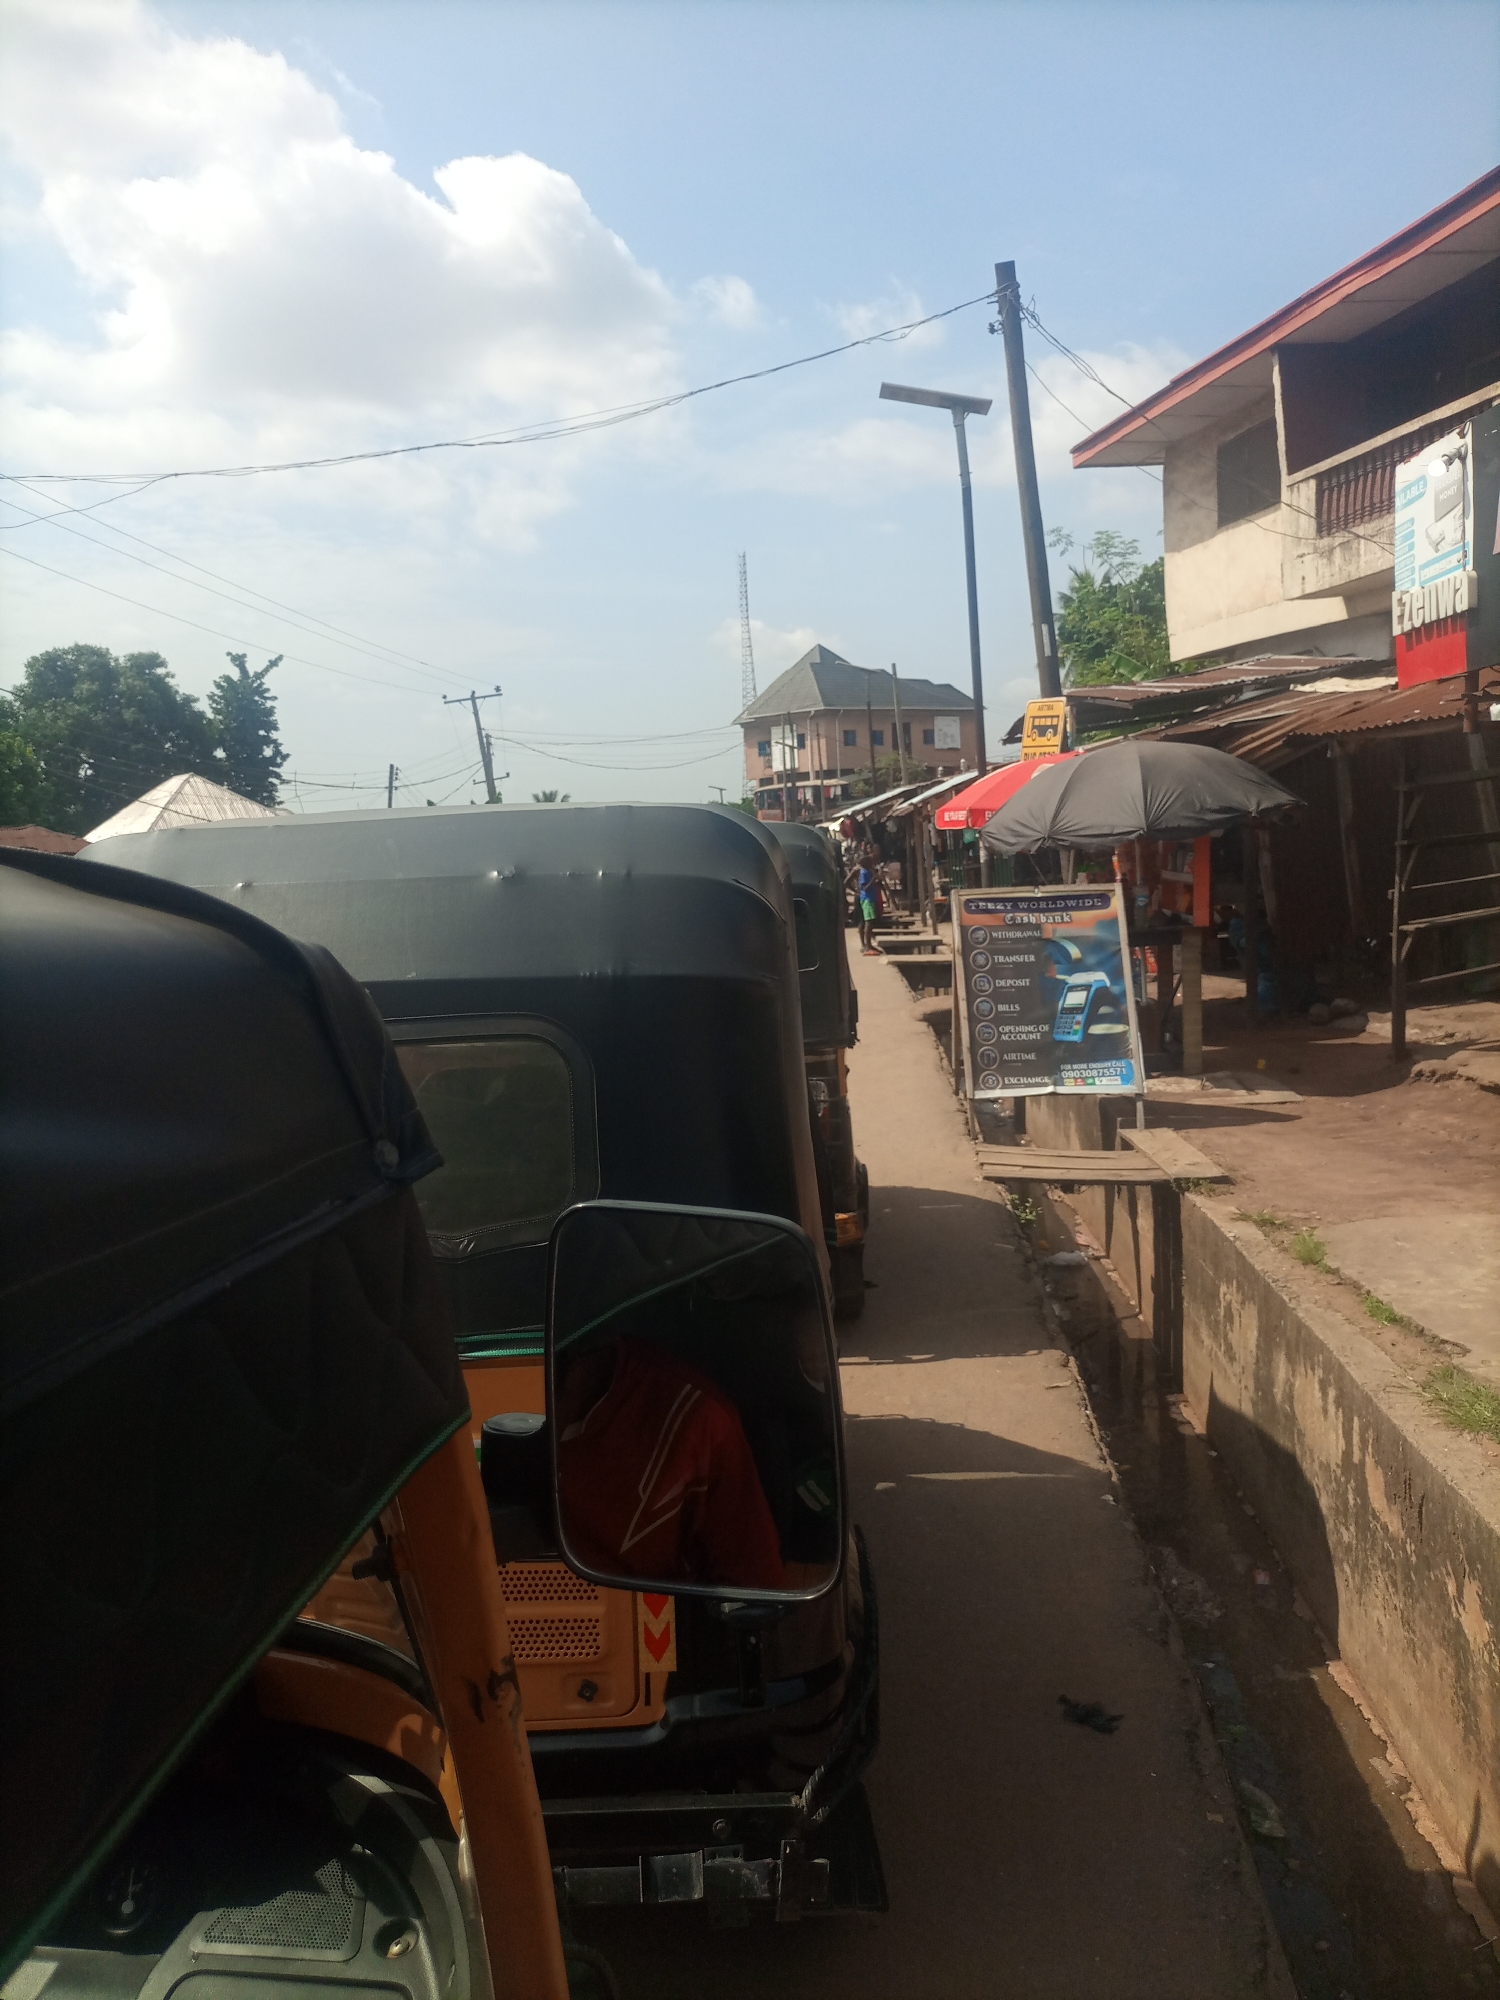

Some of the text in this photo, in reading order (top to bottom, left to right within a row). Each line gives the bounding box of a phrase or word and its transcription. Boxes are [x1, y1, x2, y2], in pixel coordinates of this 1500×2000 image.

[1439, 484, 1458, 503] MONEY
[1392, 572, 1468, 637] Ezenwa
[1017, 899, 1102, 909] WORLDWIDE
[1005, 912, 1071, 924] Cash bank
[991, 929, 1042, 938] WITHDRAWAL
[993, 955, 1036, 963] TRANSFER
[995, 979, 1031, 987] DEPOSIT
[997, 1004, 1020, 1012] BILLS
[999, 1024, 1050, 1033] OPENING OF
[999, 1032, 1042, 1041] ACCOUNT
[1002, 1052, 1037, 1061] AIRTIME
[1061, 1067, 1126, 1078] 09030875571
[1004, 1076, 1050, 1084] EXCHANGE
